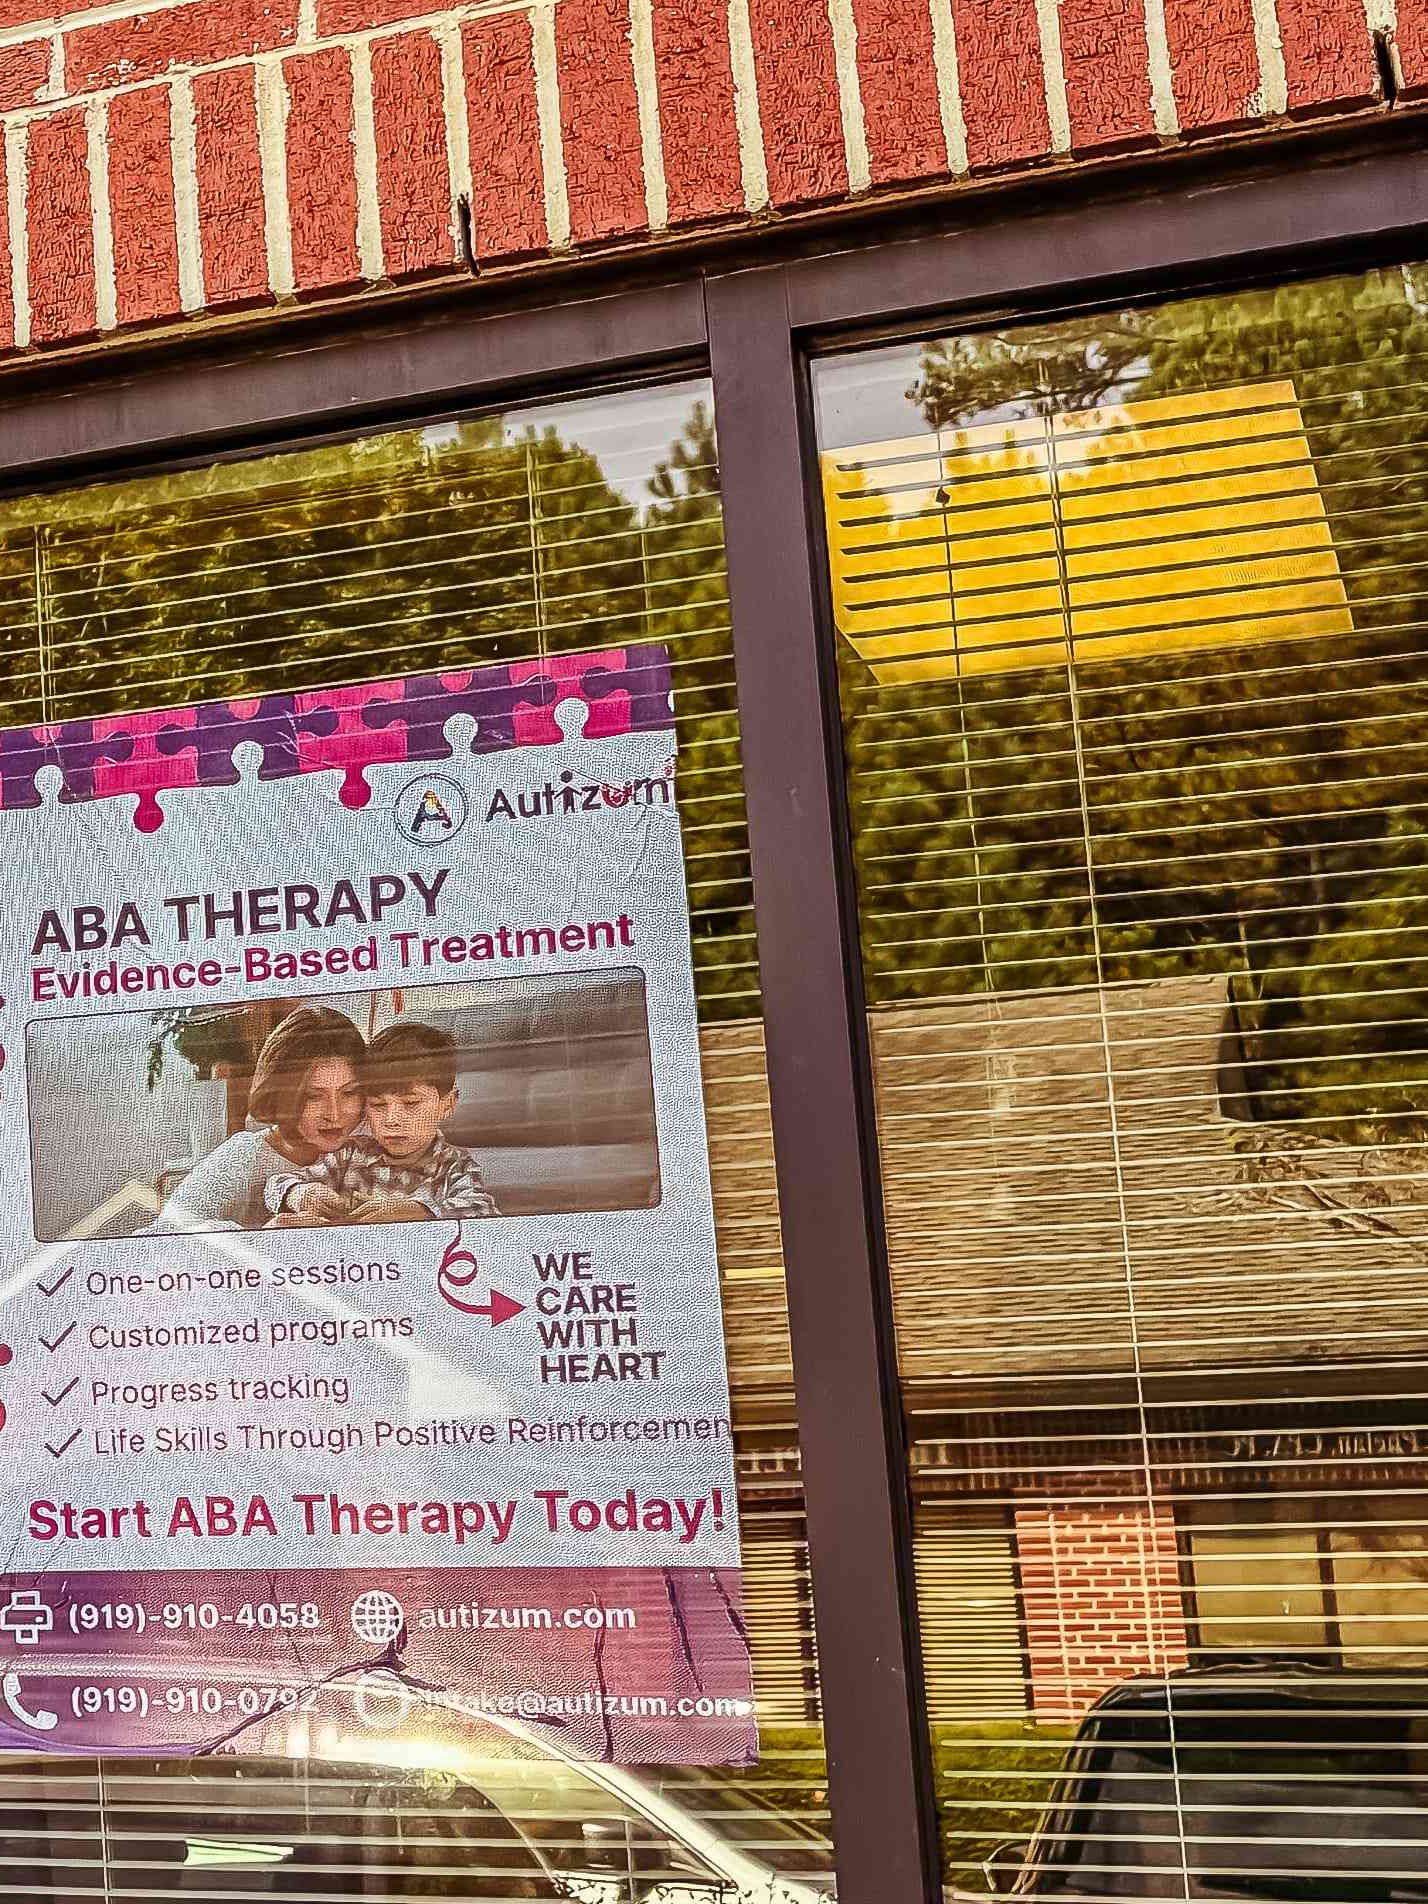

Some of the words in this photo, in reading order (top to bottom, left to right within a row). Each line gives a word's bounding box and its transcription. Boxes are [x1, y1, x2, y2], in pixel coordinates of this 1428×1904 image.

[485, 769, 671, 823] Autizum
[29, 901, 152, 956] ABA
[164, 867, 451, 944] THERAPY
[31, 936, 378, 1002] Evidence-Based
[390, 912, 636, 969] Treatment
[86, 1267, 262, 1296] One-on-one
[271, 1258, 402, 1288] sessions
[532, 1251, 594, 1282] WE
[535, 1282, 638, 1316] CARE
[88, 1318, 261, 1350] Customized
[270, 1316, 414, 1349] programs
[536, 1318, 638, 1350] WITH
[539, 1350, 666, 1384] HEART
[91, 1380, 219, 1410] Progress
[228, 1372, 349, 1404] tracking
[94, 1427, 146, 1457] Life
[155, 1424, 228, 1453] Skills
[235, 1422, 363, 1455] Through
[373, 1418, 496, 1448] Positive
[507, 1415, 730, 1445] Reinforcemen
[28, 1496, 152, 1542] Start
[166, 1494, 280, 1538] ABA
[292, 1493, 518, 1547] Therapy
[533, 1486, 726, 1545] Today!
[69, 1601, 321, 1634] (919)-910-4058
[418, 1602, 637, 1631] autizum.com
